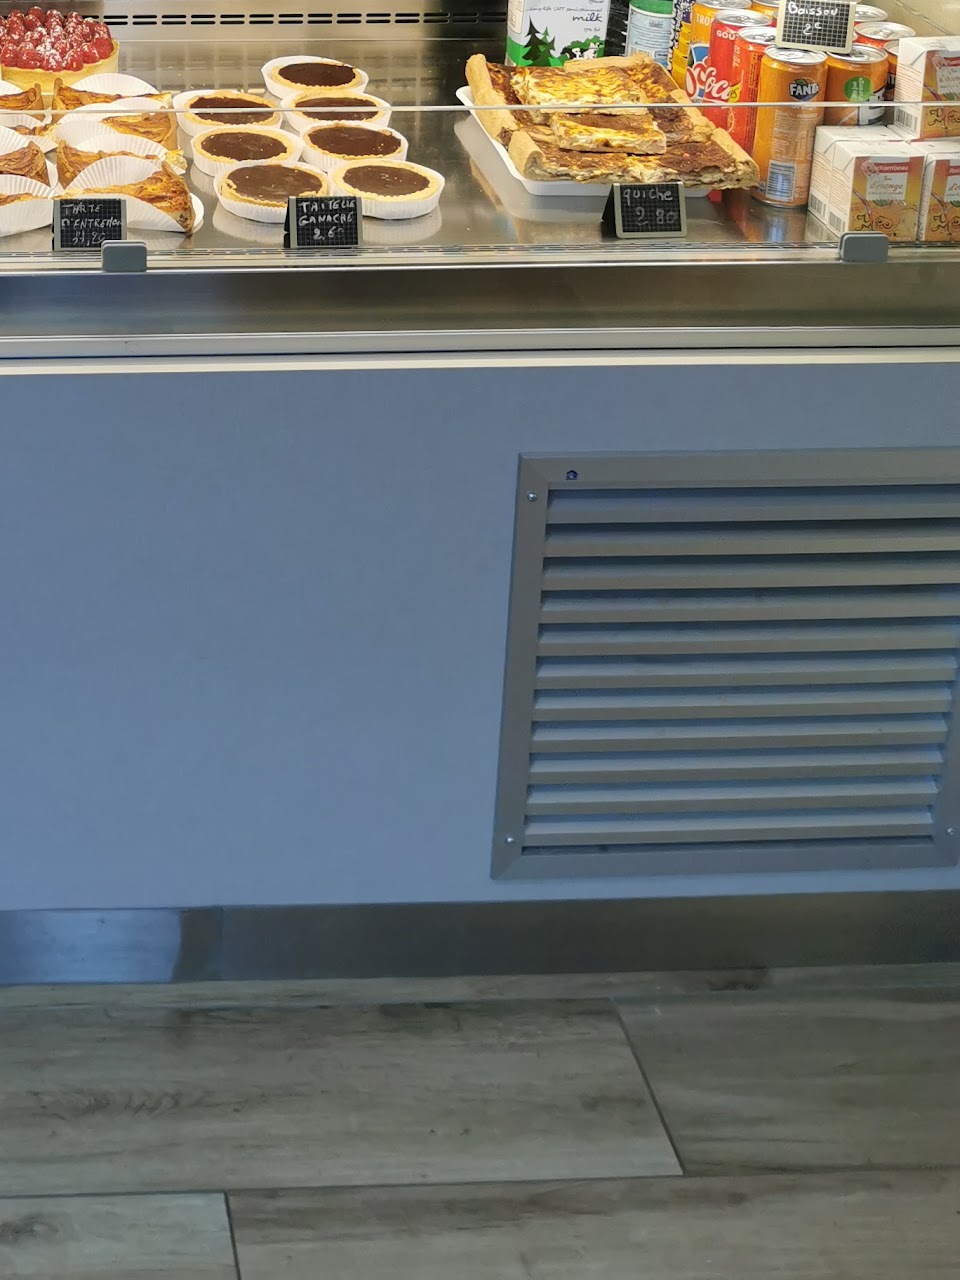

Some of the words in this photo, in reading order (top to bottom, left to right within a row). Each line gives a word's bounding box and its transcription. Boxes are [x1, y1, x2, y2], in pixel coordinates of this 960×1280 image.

[572, 12, 603, 23] milk
[789, 82, 820, 96] FANTA
[623, 187, 673, 207] quiche
[61, 202, 103, 216] TARTE
[298, 211, 354, 227] GANACHE
